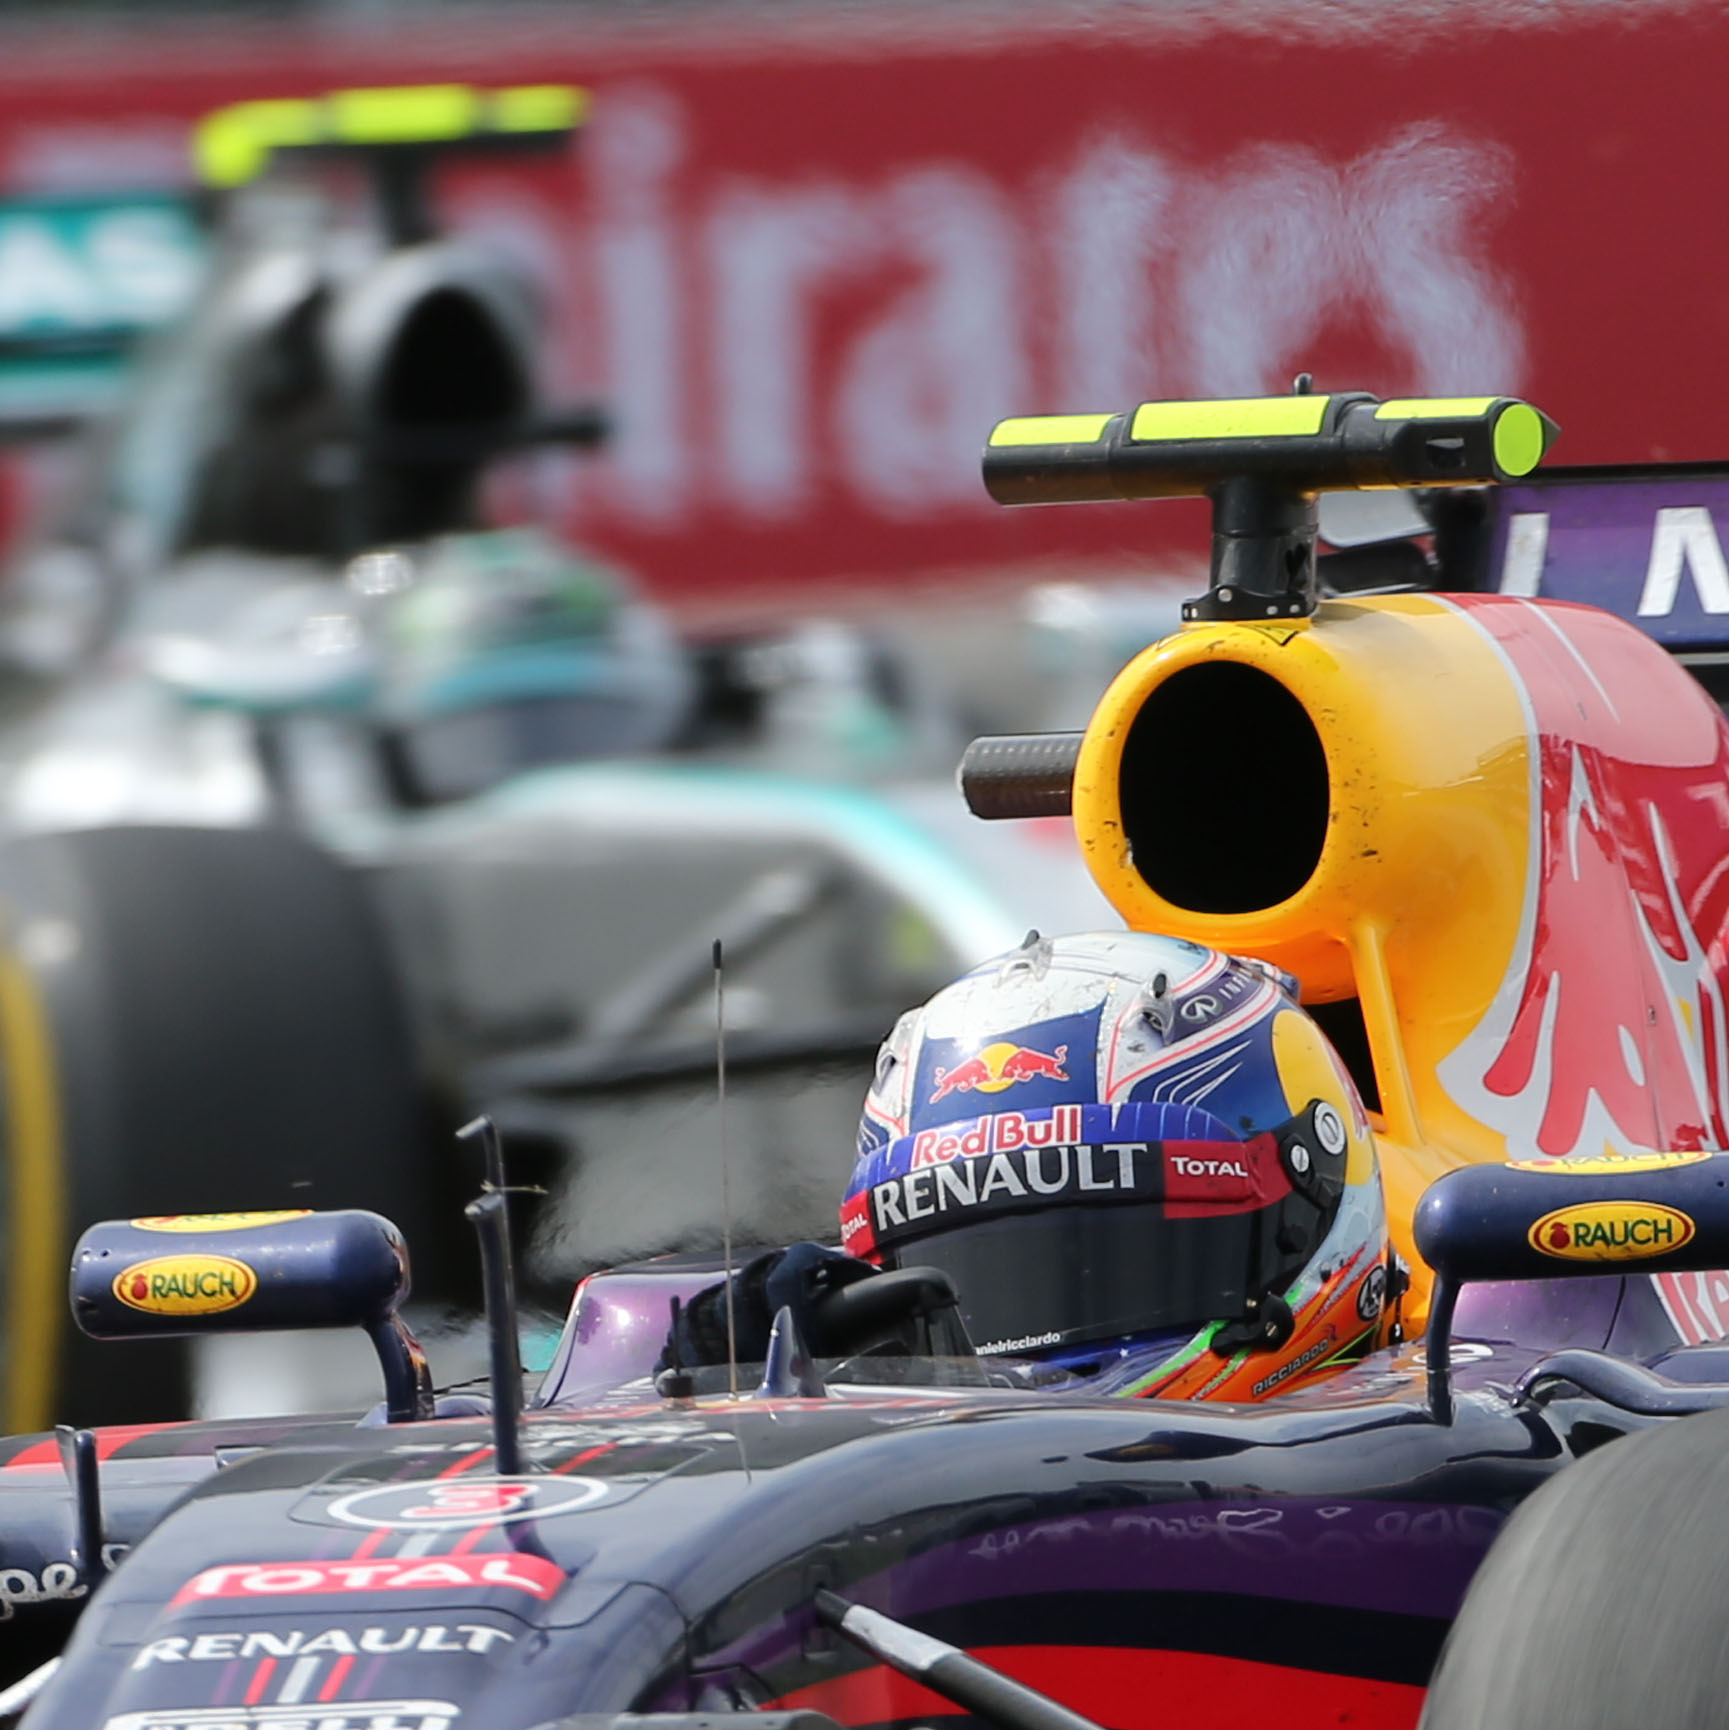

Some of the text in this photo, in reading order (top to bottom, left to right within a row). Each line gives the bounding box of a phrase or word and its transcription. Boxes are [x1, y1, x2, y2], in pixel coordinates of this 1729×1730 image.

[910, 1104, 1083, 1171] Red Bull
[873, 1142, 1149, 1231] RENAULT
[1170, 1156, 1250, 1178] TOTAL
[1574, 1218, 1674, 1248] RAUCH
[151, 1271, 236, 1299] RAUCH
[1252, 1338, 1330, 1397] RICCIARDO
[401, 1480, 540, 1520] 3
[194, 1556, 543, 1597] TOTAL
[131, 1624, 515, 1672] RENAULT
